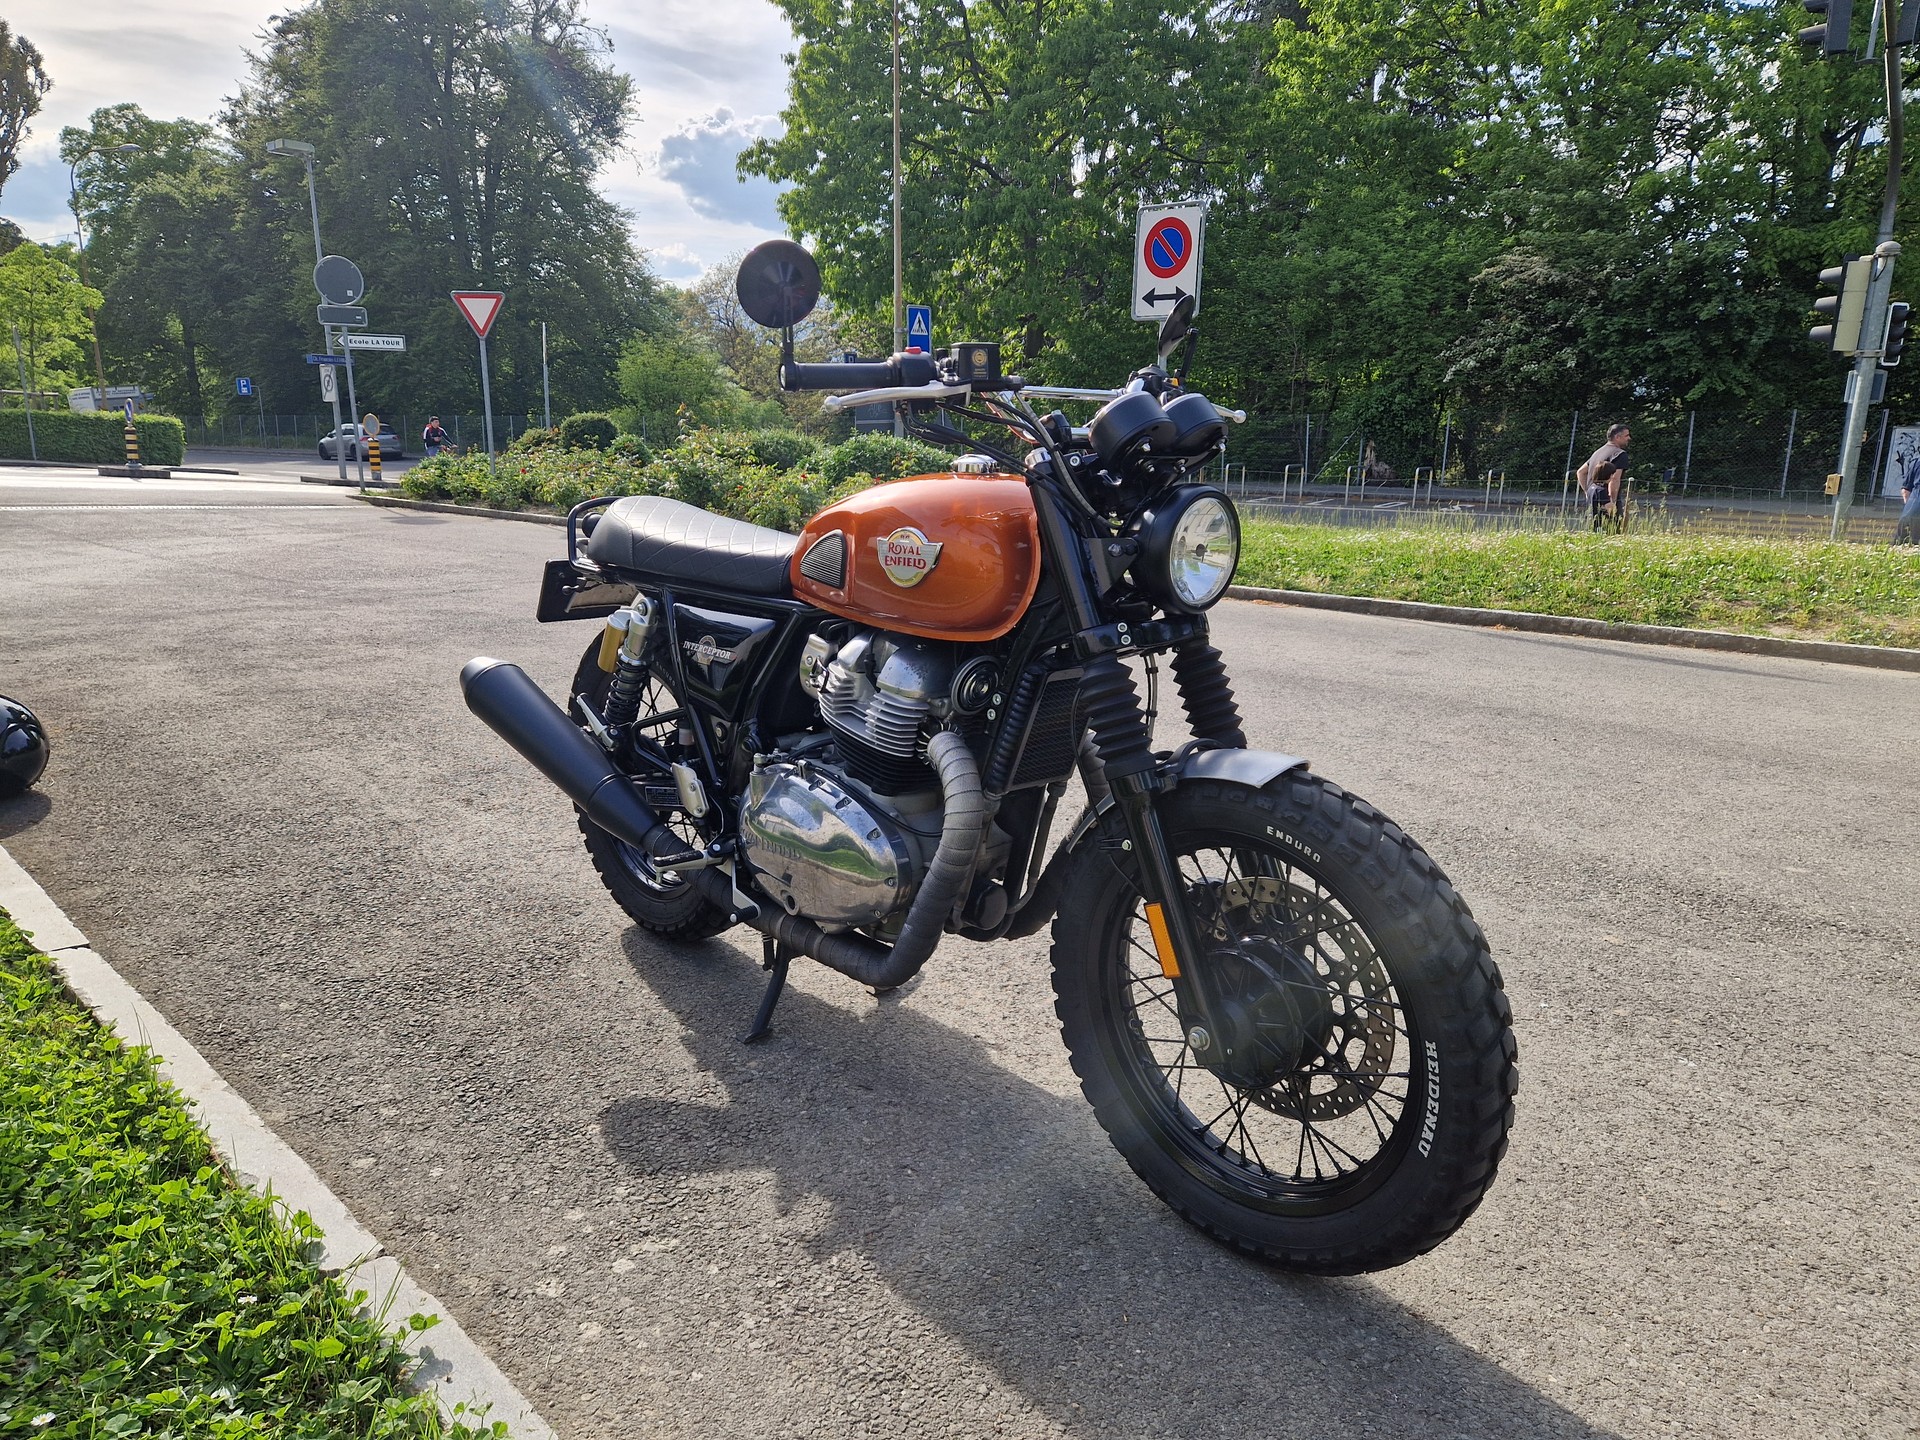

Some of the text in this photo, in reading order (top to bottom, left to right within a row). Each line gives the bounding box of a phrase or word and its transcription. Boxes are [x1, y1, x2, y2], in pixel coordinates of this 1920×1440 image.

[888, 541, 921, 556] ROYAL
[884, 555, 927, 570] ENFIELD
[682, 640, 731, 660] INTERCEPTOR
[1266, 825, 1321, 863] ENDURO
[1418, 1040, 1440, 1158] HEIDENAU
